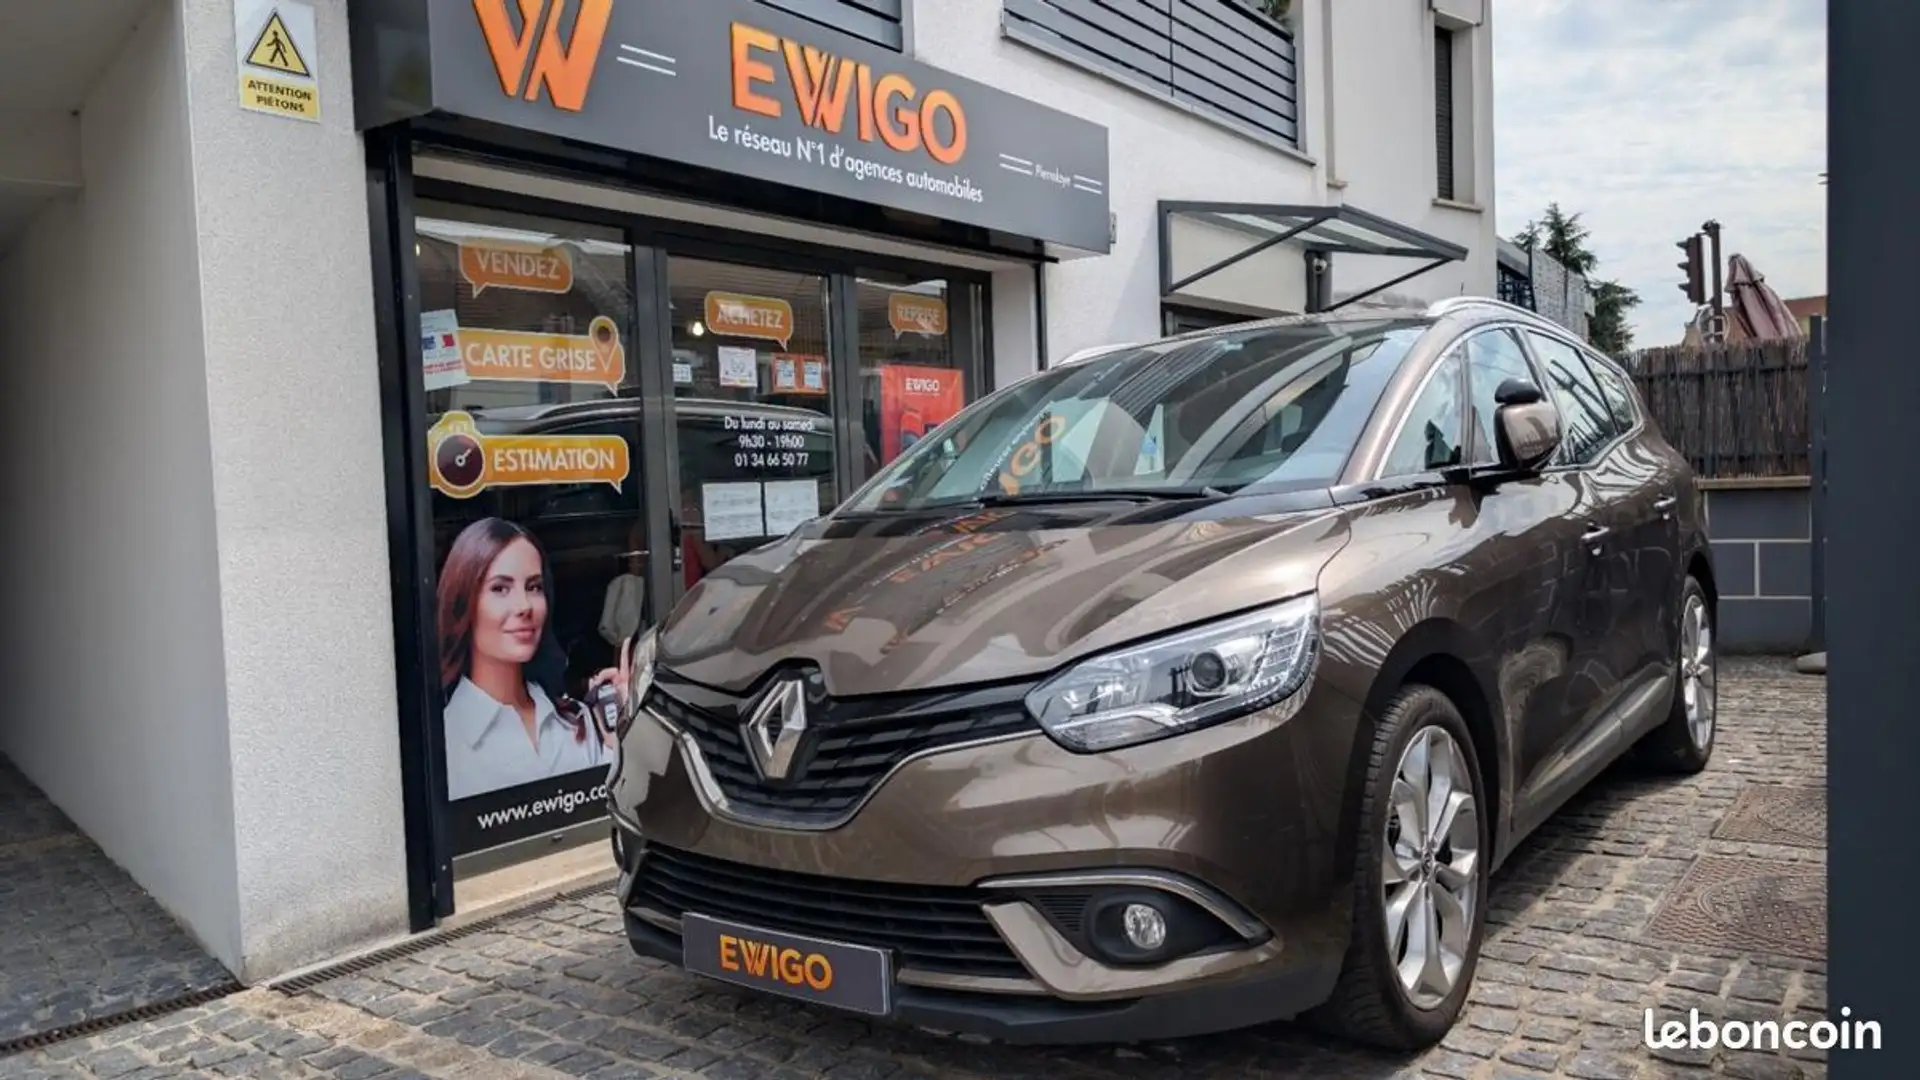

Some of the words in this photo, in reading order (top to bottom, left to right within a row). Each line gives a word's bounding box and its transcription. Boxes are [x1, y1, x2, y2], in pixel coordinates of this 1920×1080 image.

[248, 80, 312, 101] ATTENTION
[730, 20, 968, 165] EWIGO
[708, 115, 729, 142] Le
[734, 124, 791, 158] réseau
[906, 172, 984, 203] automobiles
[475, 250, 562, 280] VENDEZ
[716, 304, 783, 329] ACHETEZ
[466, 343, 531, 369] CARTE
[539, 346, 597, 371] GRISE
[905, 378, 940, 392] EWIGO
[724, 416, 739, 430] Du
[741, 415, 765, 430] lundi
[768, 421, 780, 430] au
[738, 434, 765, 448] 9h30
[775, 435, 805, 448] 19h00
[493, 448, 616, 471] ESTIMATION
[734, 453, 748, 467] 01
[751, 453, 765, 467] 34
[767, 453, 780, 466] 66
[782, 453, 795, 466] 50
[796, 452, 809, 465] 77
[719, 934, 833, 991] EWIGO
